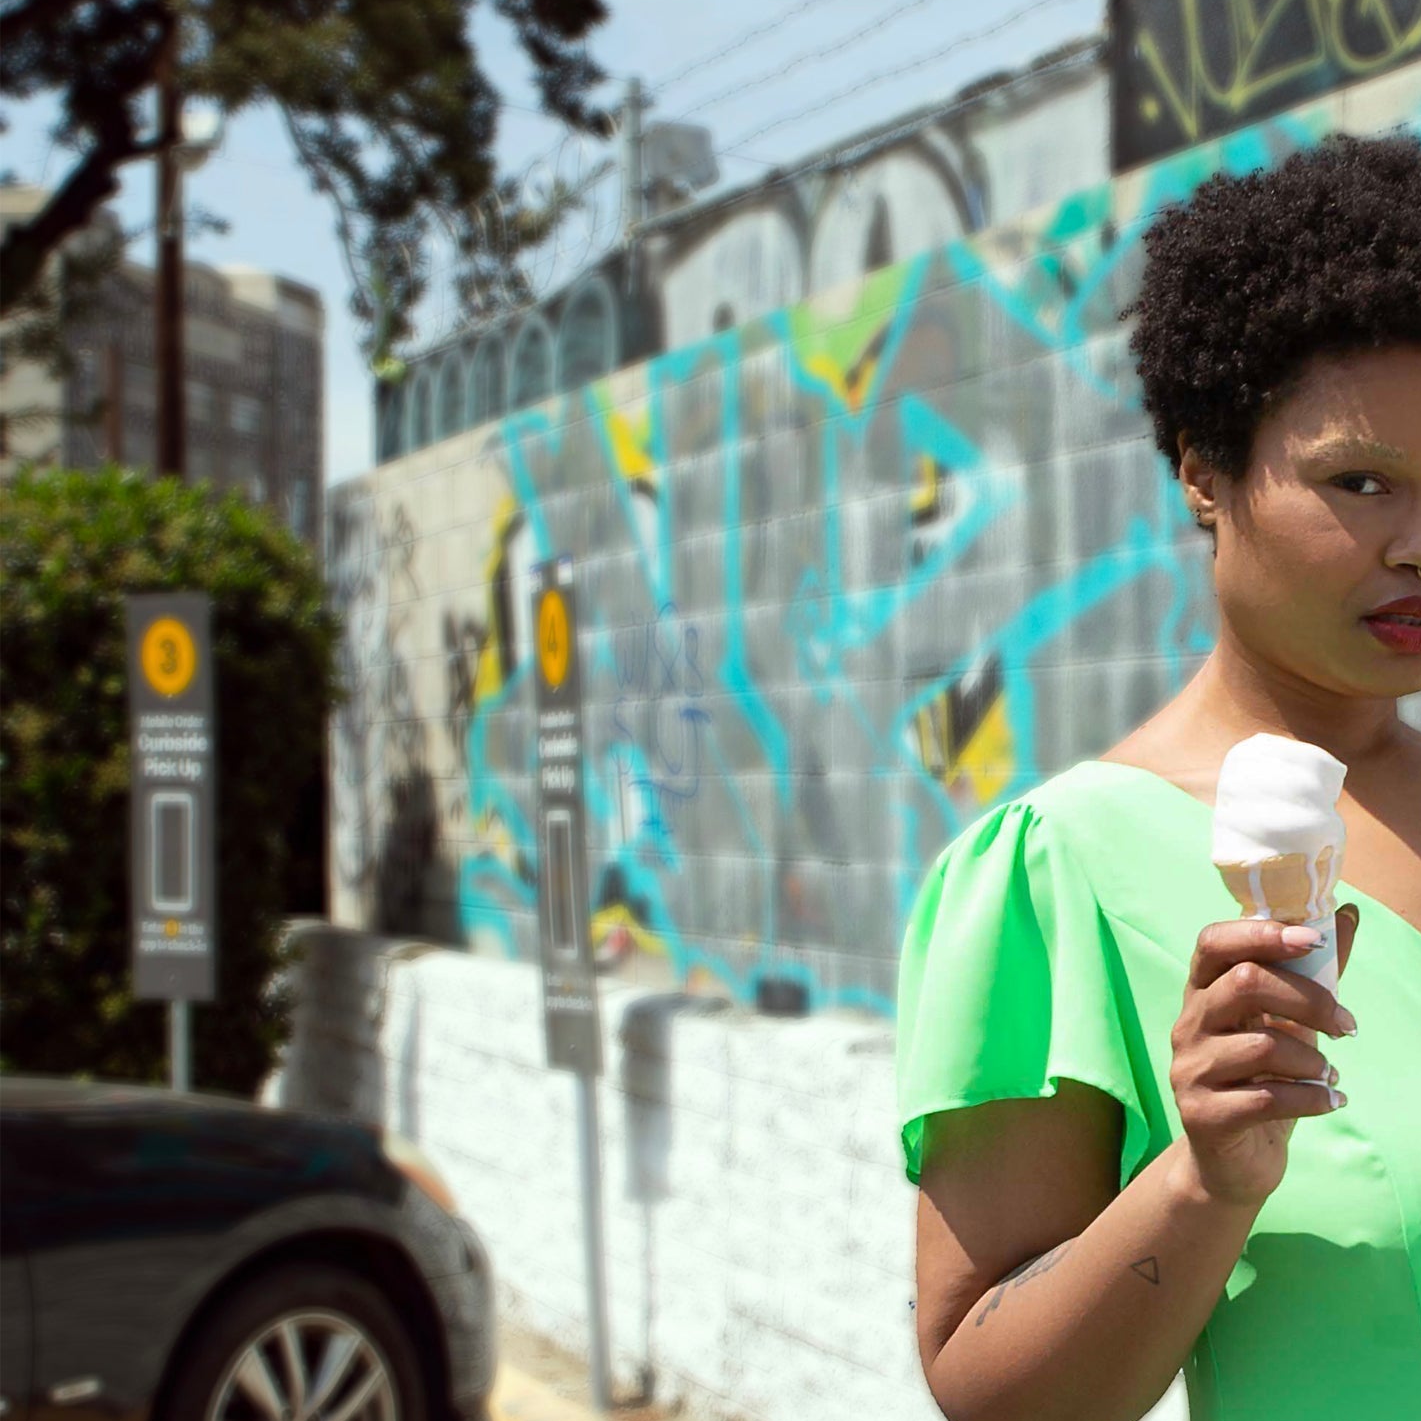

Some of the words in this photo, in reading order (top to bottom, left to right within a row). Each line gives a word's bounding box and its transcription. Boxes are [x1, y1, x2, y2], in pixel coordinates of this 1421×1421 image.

[159, 638, 177, 675] 3
[138, 732, 208, 752] Curbside
[144, 757, 177, 777] Pick
[179, 758, 202, 781] Up
